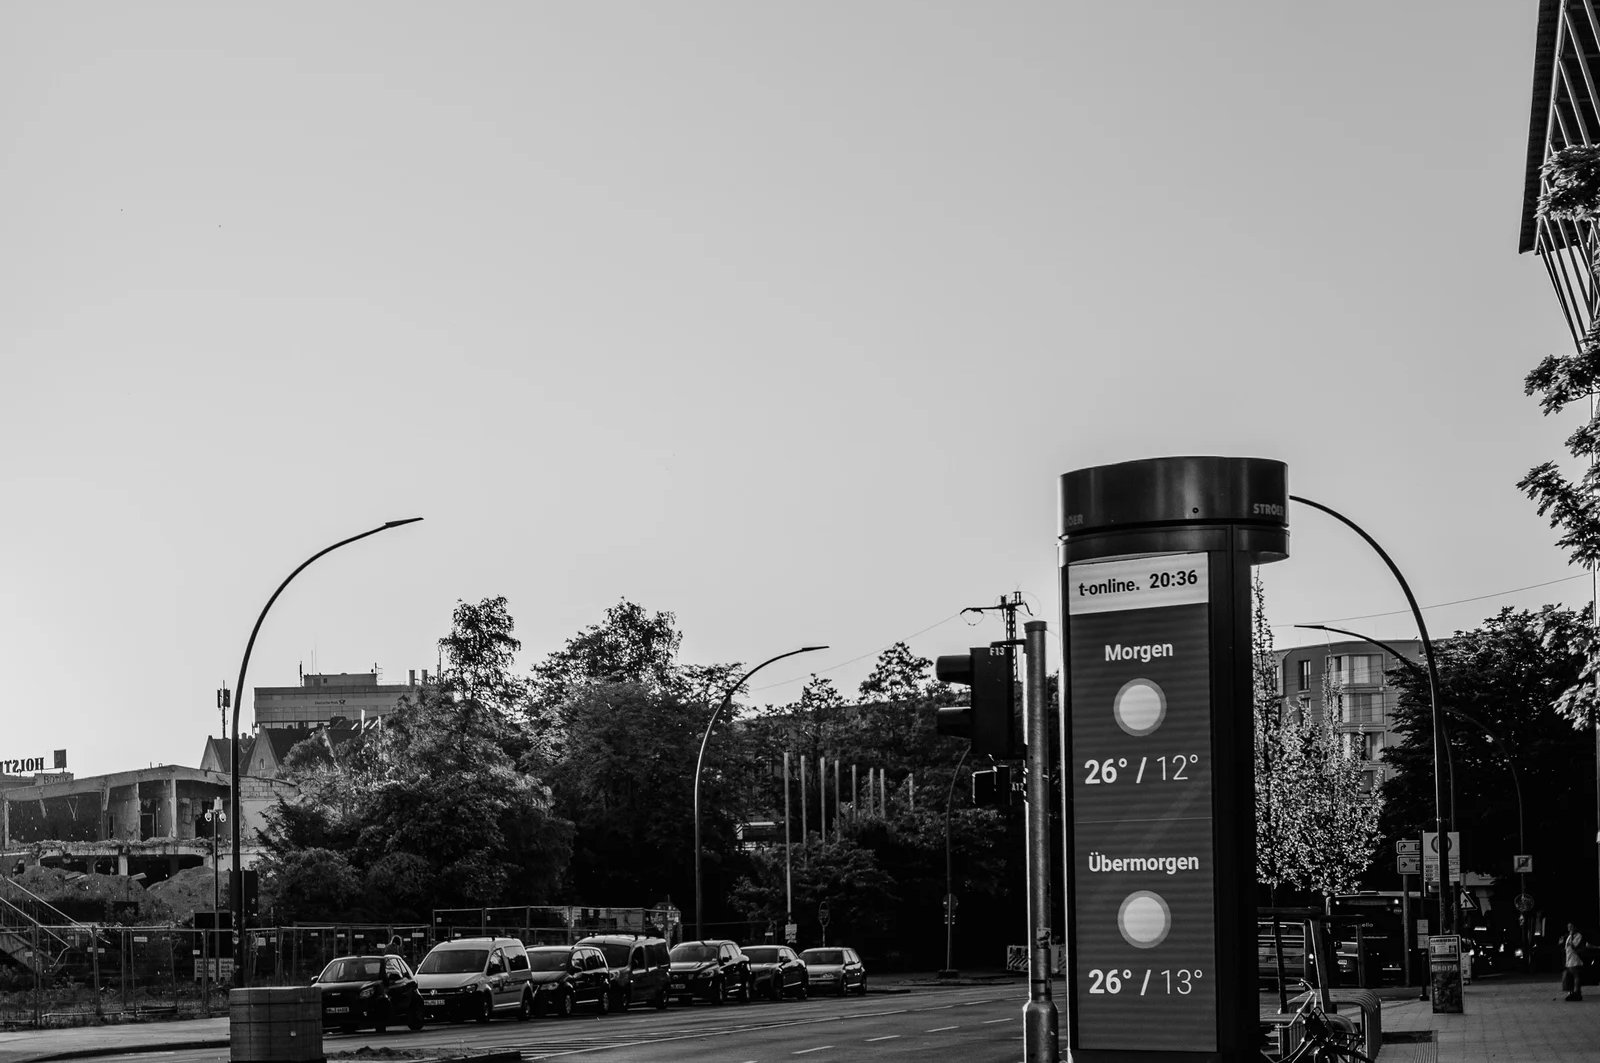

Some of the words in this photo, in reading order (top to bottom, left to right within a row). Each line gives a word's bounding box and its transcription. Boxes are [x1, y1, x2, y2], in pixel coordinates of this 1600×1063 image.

[1079, 578, 1140, 596] t-online.
[1149, 569, 1198, 589] 20:36
[990, 648, 1005, 656] F13
[1105, 643, 1173, 663] Morgen
[1084, 757, 1128, 785] 26°
[1135, 756, 1147, 784] /
[1156, 754, 1199, 781] 12°
[1088, 851, 1199, 875] Übermorgen
[1088, 969, 1132, 994] 26°
[1140, 969, 1152, 996] /
[1160, 969, 1203, 995] 13°
